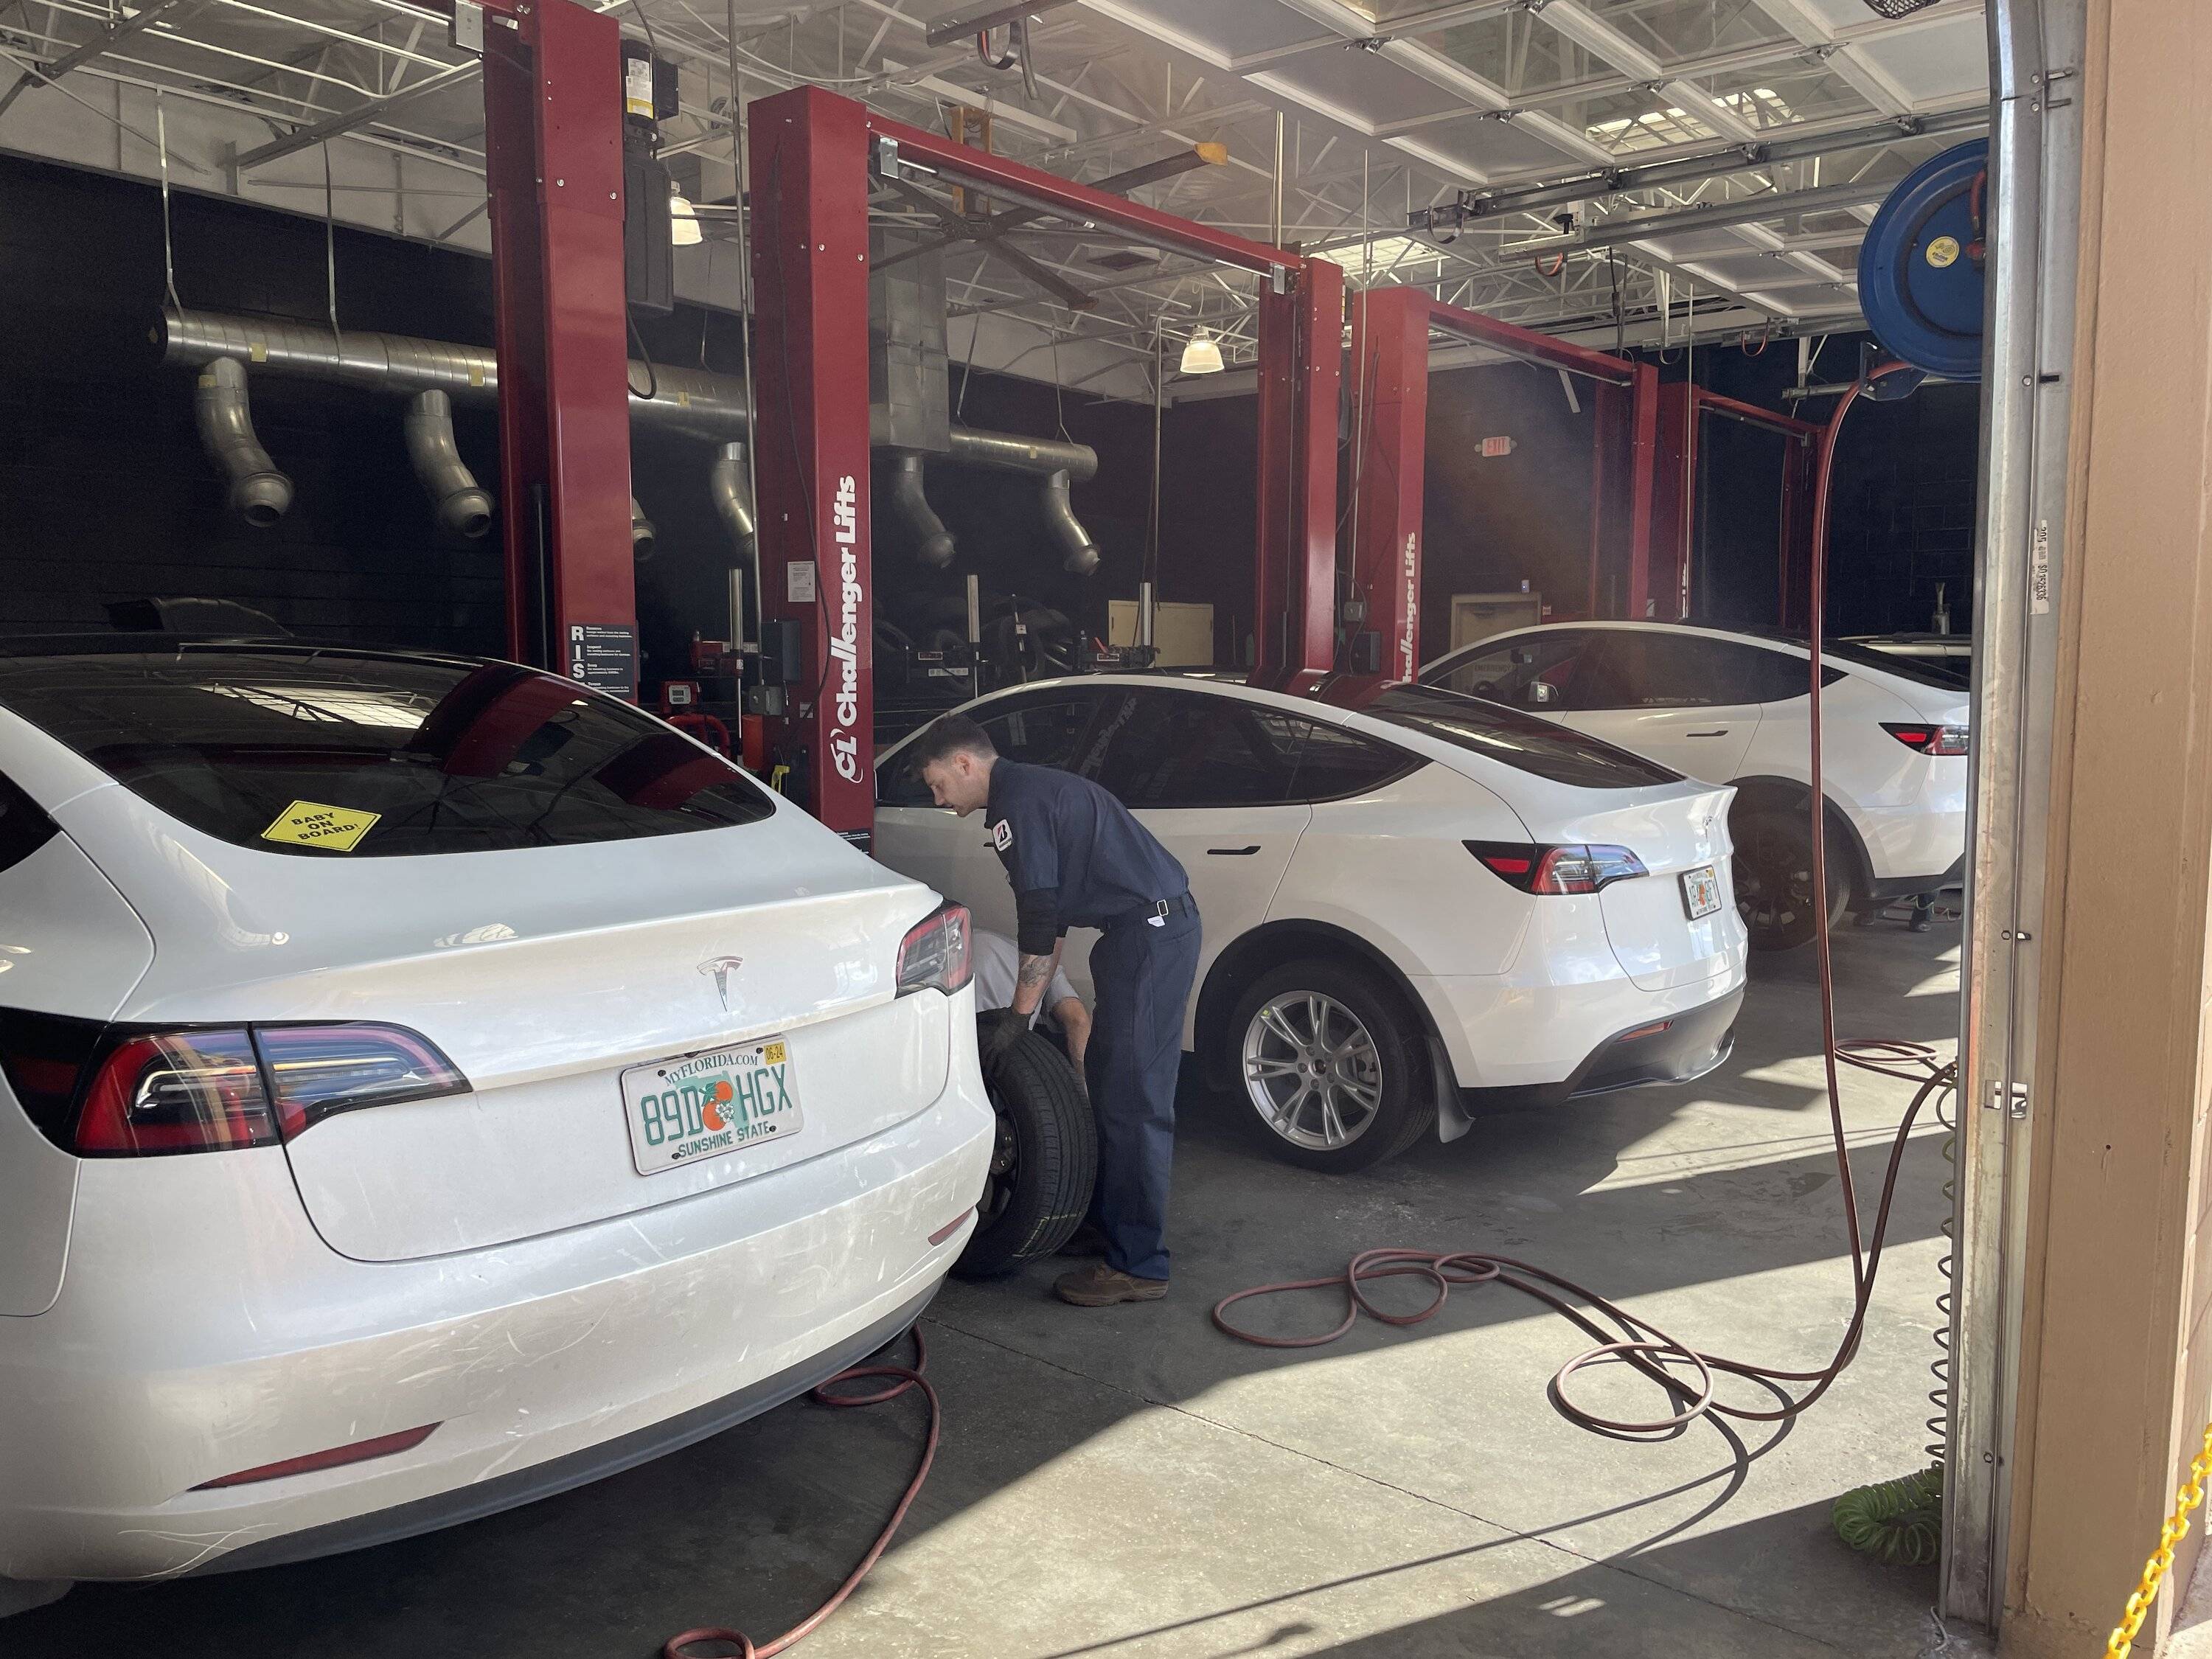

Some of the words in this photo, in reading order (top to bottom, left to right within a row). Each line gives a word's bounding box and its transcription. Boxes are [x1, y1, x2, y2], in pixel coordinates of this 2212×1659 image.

[834, 475, 856, 544] Lifts
[1405, 532, 1416, 577] Lifts
[571, 625, 585, 641] R
[830, 547, 863, 727] Challenger
[1400, 580, 1416, 684] hallenger
[572, 663, 585, 679] S
[292, 813, 335, 825] BABY
[298, 824, 361, 840] BOARD!
[307, 820, 334, 830] ON
[664, 1052, 759, 1087] MYFLORIDA.COM
[640, 1085, 703, 1147] 89D
[735, 1063, 793, 1121] HGX
[678, 1130, 734, 1158] SUNSHINE
[737, 1120, 771, 1142] STATE
